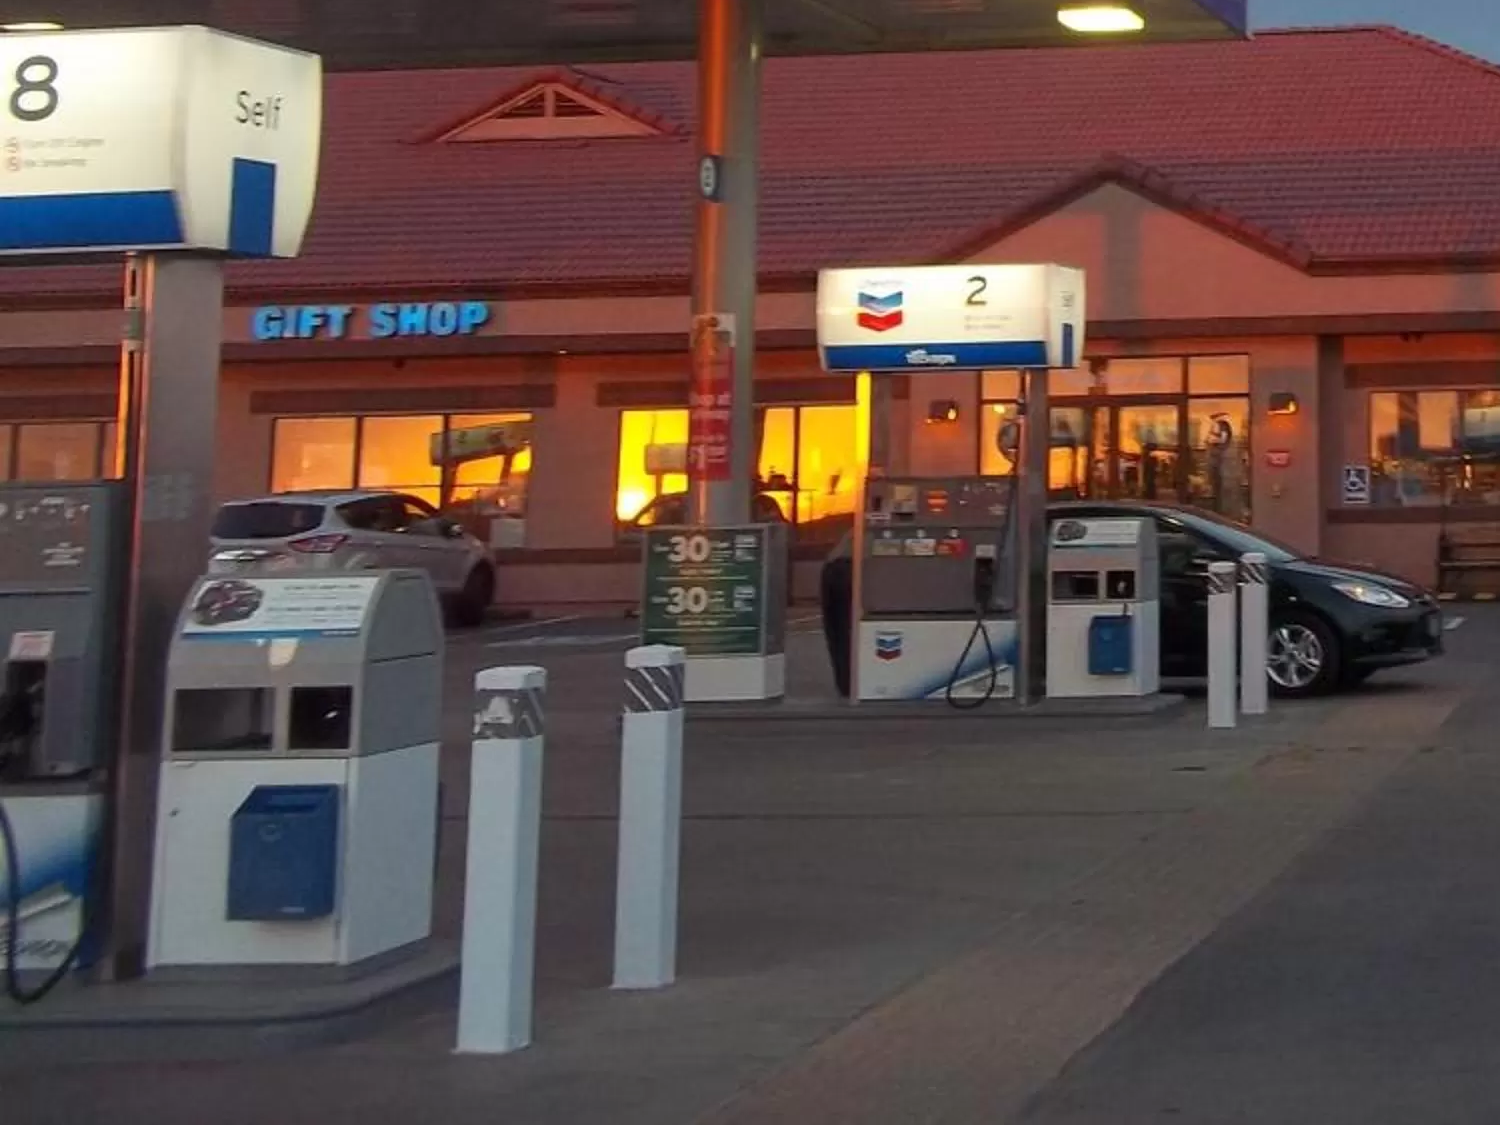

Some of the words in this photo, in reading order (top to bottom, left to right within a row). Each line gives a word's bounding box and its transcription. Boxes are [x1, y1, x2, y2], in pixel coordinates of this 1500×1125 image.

[9, 55, 59, 122] 8
[235, 90, 284, 130] Self
[965, 275, 988, 306] 2
[253, 304, 352, 340] GIFT
[369, 301, 489, 338] SHOP
[667, 534, 711, 562] 30
[665, 585, 709, 614] 30
